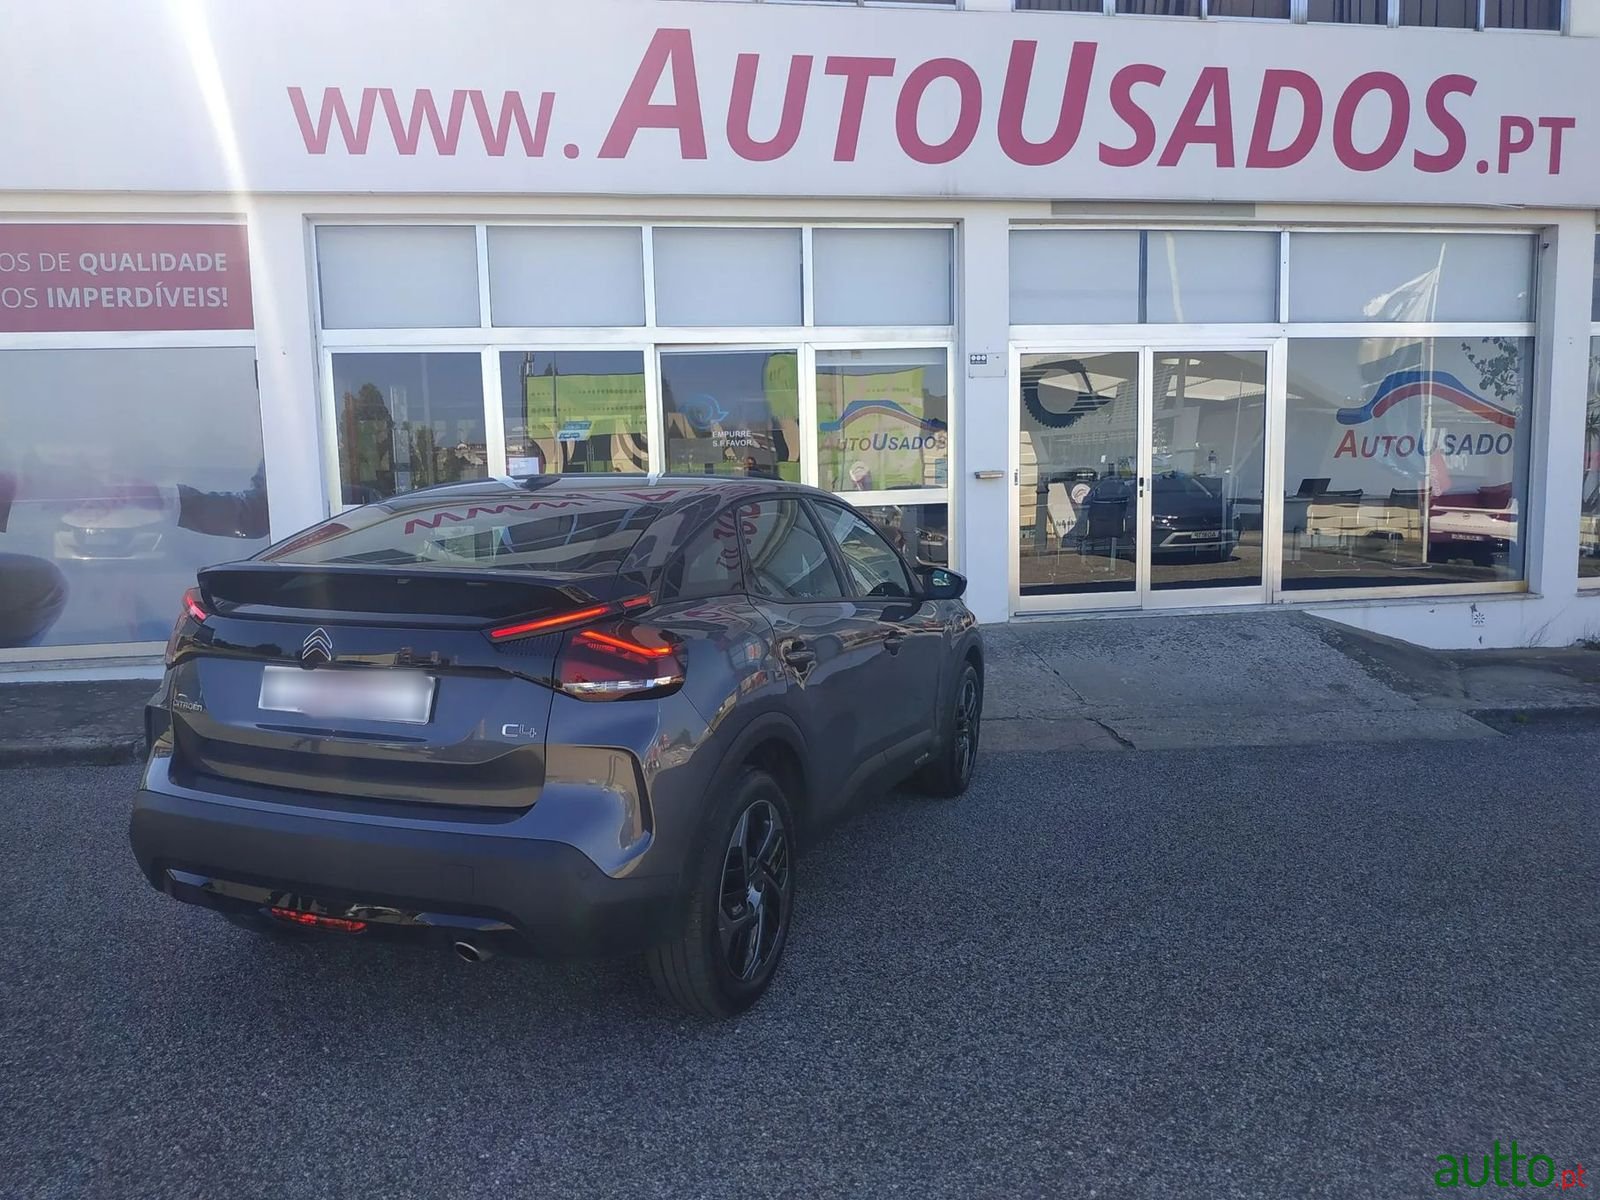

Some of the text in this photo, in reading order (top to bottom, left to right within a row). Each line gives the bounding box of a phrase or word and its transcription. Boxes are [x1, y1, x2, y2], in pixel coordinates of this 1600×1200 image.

[39, 252, 71, 272] DE
[78, 252, 227, 275] QUALIDADE
[1, 281, 229, 308] OS IMPERDÍVEIS!
[502, 723, 537, 738] C4
